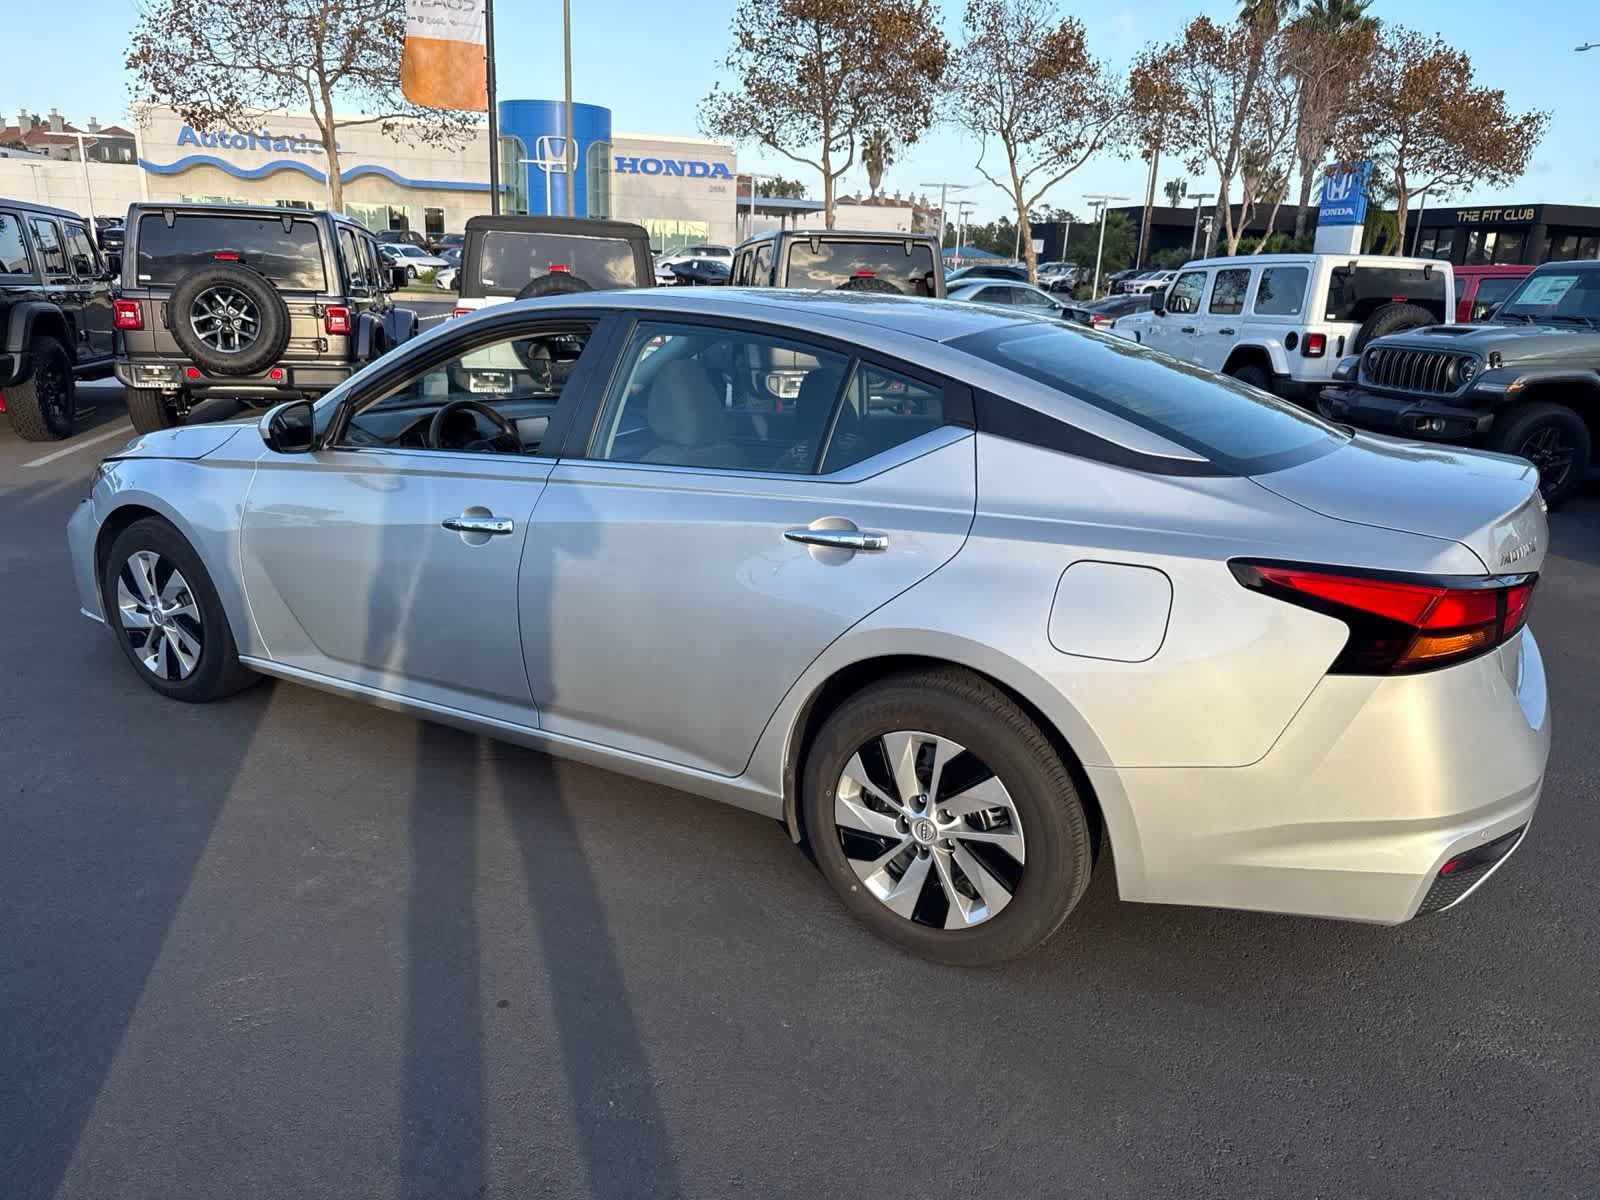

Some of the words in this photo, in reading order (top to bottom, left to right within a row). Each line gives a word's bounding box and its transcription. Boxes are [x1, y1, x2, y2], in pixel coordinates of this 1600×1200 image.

[614, 156, 734, 180] HONDA
[1456, 211, 1480, 222] THE
[1482, 209, 1502, 221] FIT
[1503, 208, 1535, 221] CLUB
